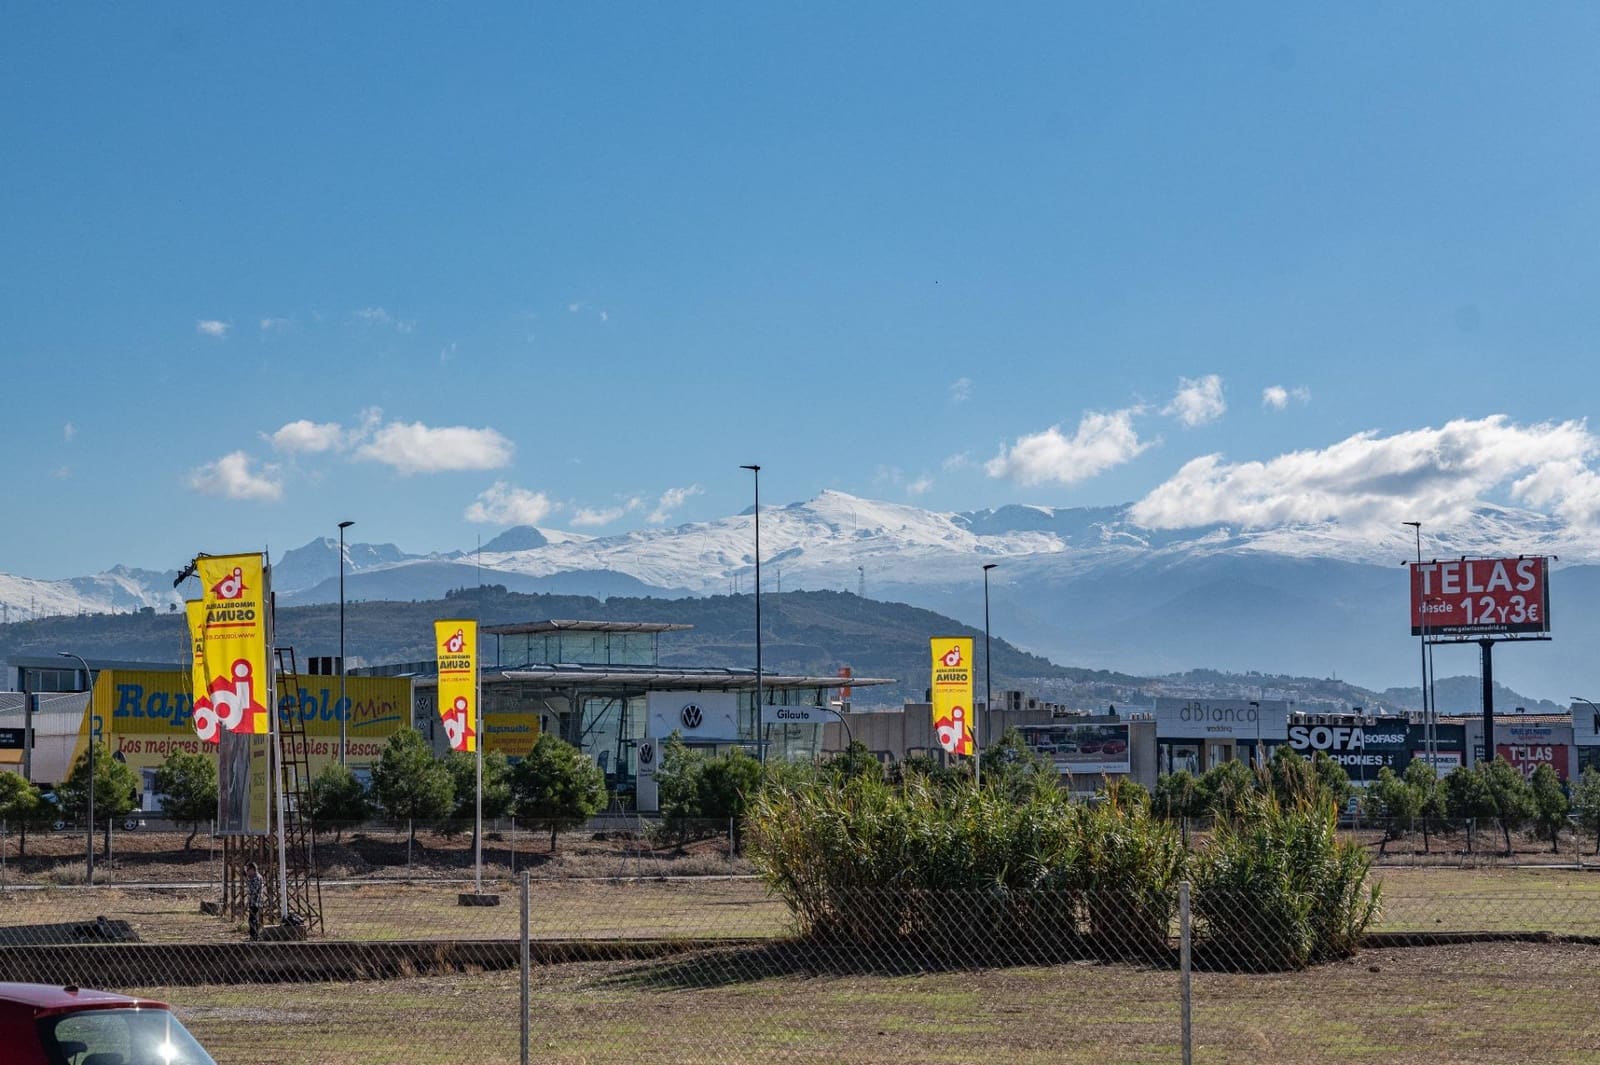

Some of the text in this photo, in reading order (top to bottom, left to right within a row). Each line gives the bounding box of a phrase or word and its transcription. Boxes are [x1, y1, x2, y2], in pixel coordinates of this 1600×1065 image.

[1416, 559, 1536, 595] TELAS
[1419, 601, 1453, 614] desde
[353, 696, 399, 721] Mini
[777, 708, 809, 720] Gilauto
[118, 737, 142, 753] Los
[1289, 726, 1365, 750] SOFA
[280, 739, 328, 755] uebles
[331, 743, 339, 760] y
